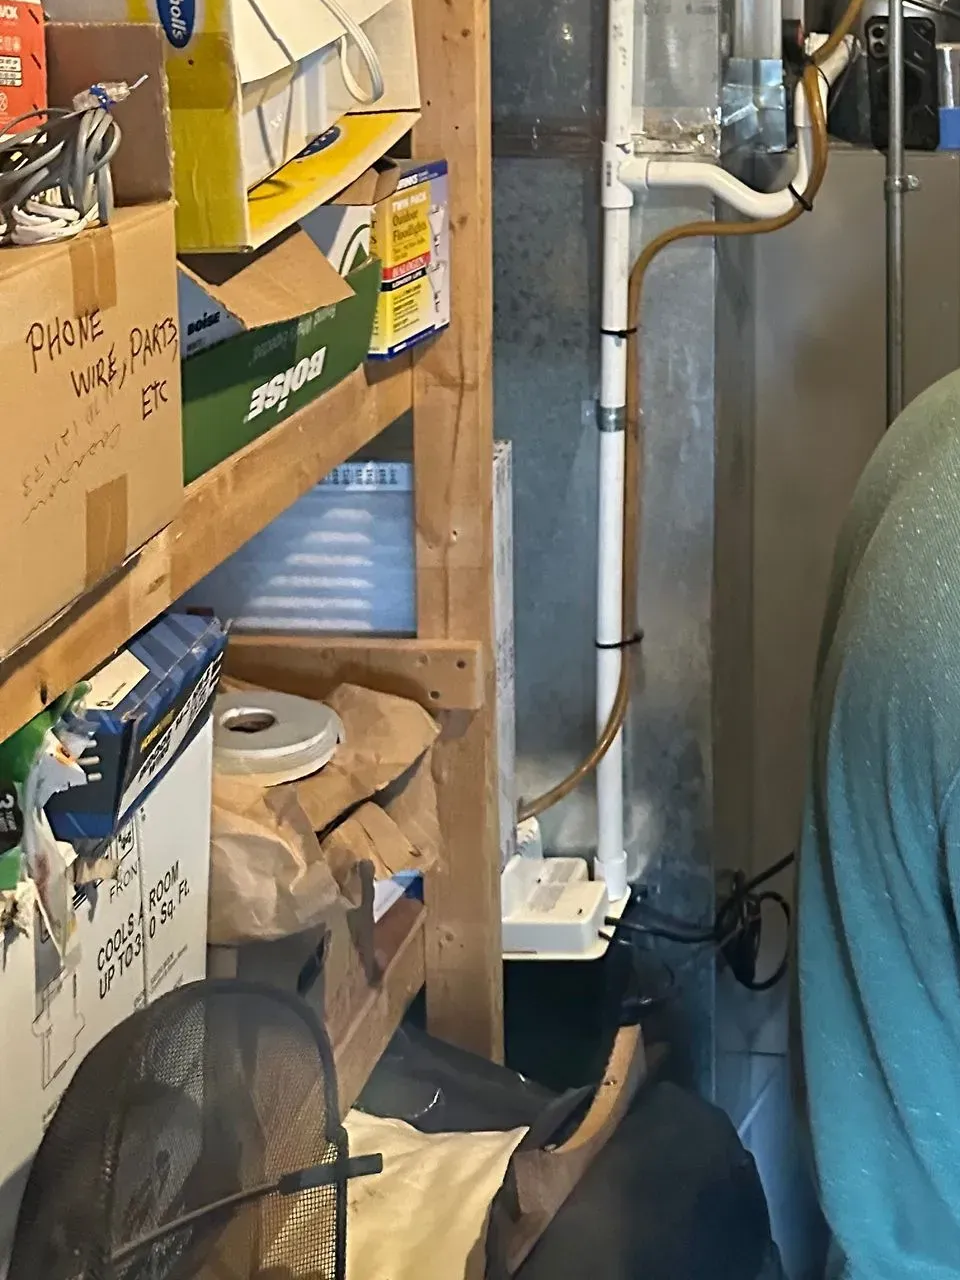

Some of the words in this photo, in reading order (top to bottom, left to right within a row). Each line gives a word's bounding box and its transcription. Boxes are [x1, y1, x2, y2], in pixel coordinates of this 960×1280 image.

[26, 308, 103, 373] PHONE
[142, 380, 168, 420] ETC
[97, 912, 134, 972] COOLS
[149, 859, 179, 913] ROOM
[100, 963, 115, 1000] UP
[118, 942, 133, 978] TO
